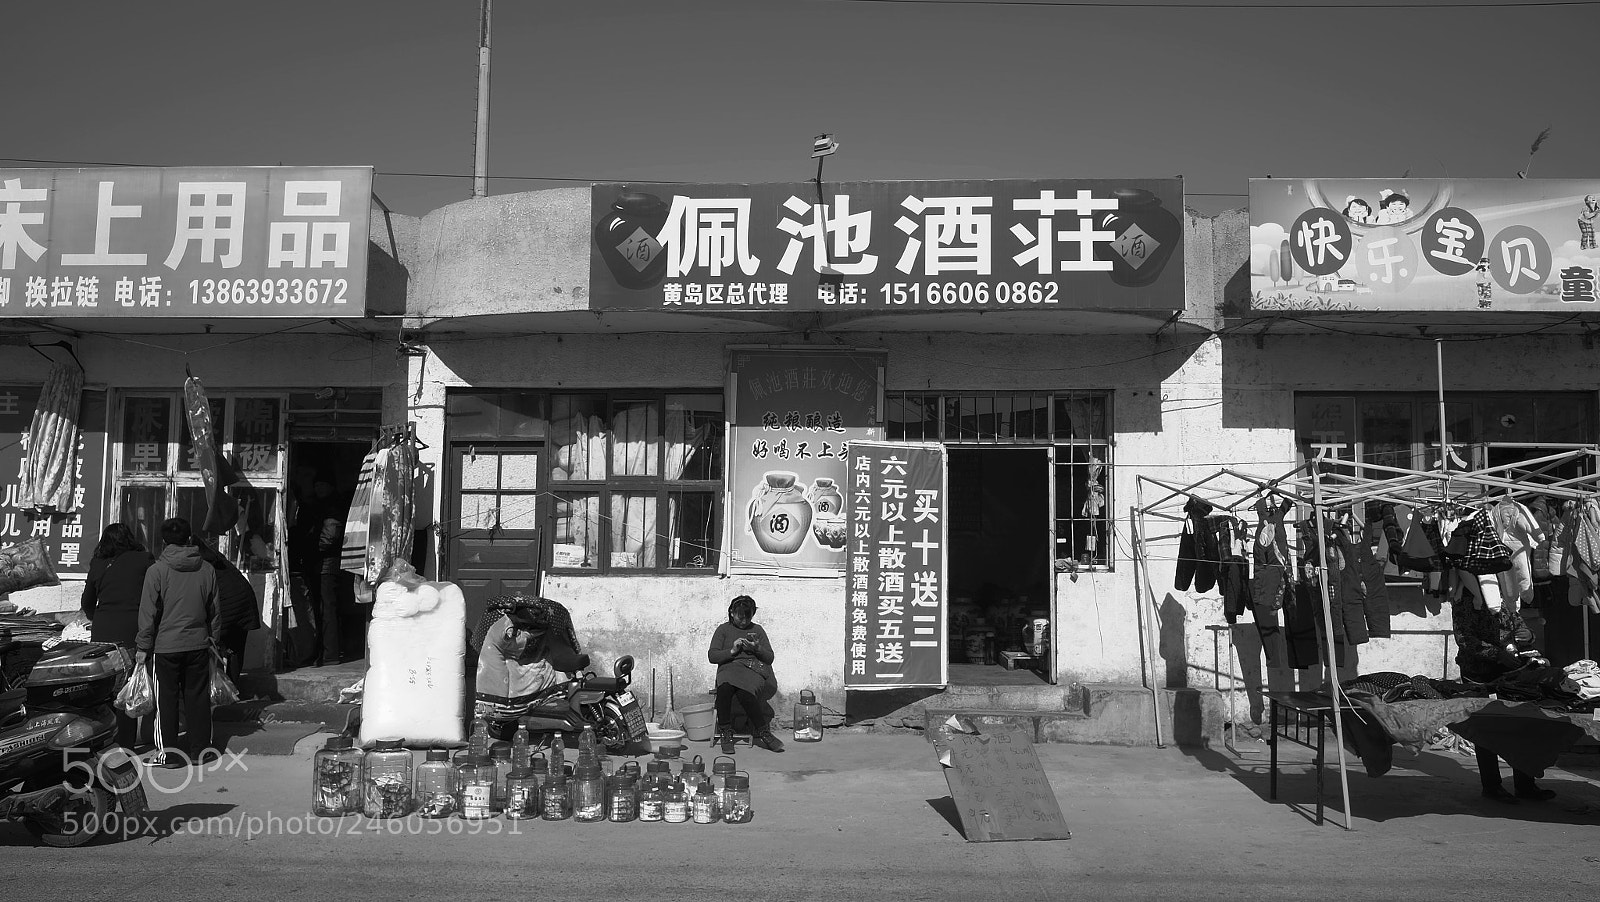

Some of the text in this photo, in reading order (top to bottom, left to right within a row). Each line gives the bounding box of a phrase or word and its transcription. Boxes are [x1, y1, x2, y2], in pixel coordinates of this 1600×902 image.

[626, 237, 650, 262] 酒
[1121, 234, 1146, 259] 酒
[1298, 217, 1541, 286] 快乐宝贝
[25, 276, 99, 307] 换拉链
[190, 279, 347, 304] 13863933672
[663, 283, 788, 305] 黄岛区总代理
[1559, 265, 1600, 304] 童
[762, 411, 846, 433] 纯粮酿造
[770, 514, 790, 534] 酒
[850, 456, 872, 676] 店内六元以上散酒桶免费使用
[875, 456, 908, 678] 六元以上散酒买五送一
[910, 489, 939, 647] 买十送三
